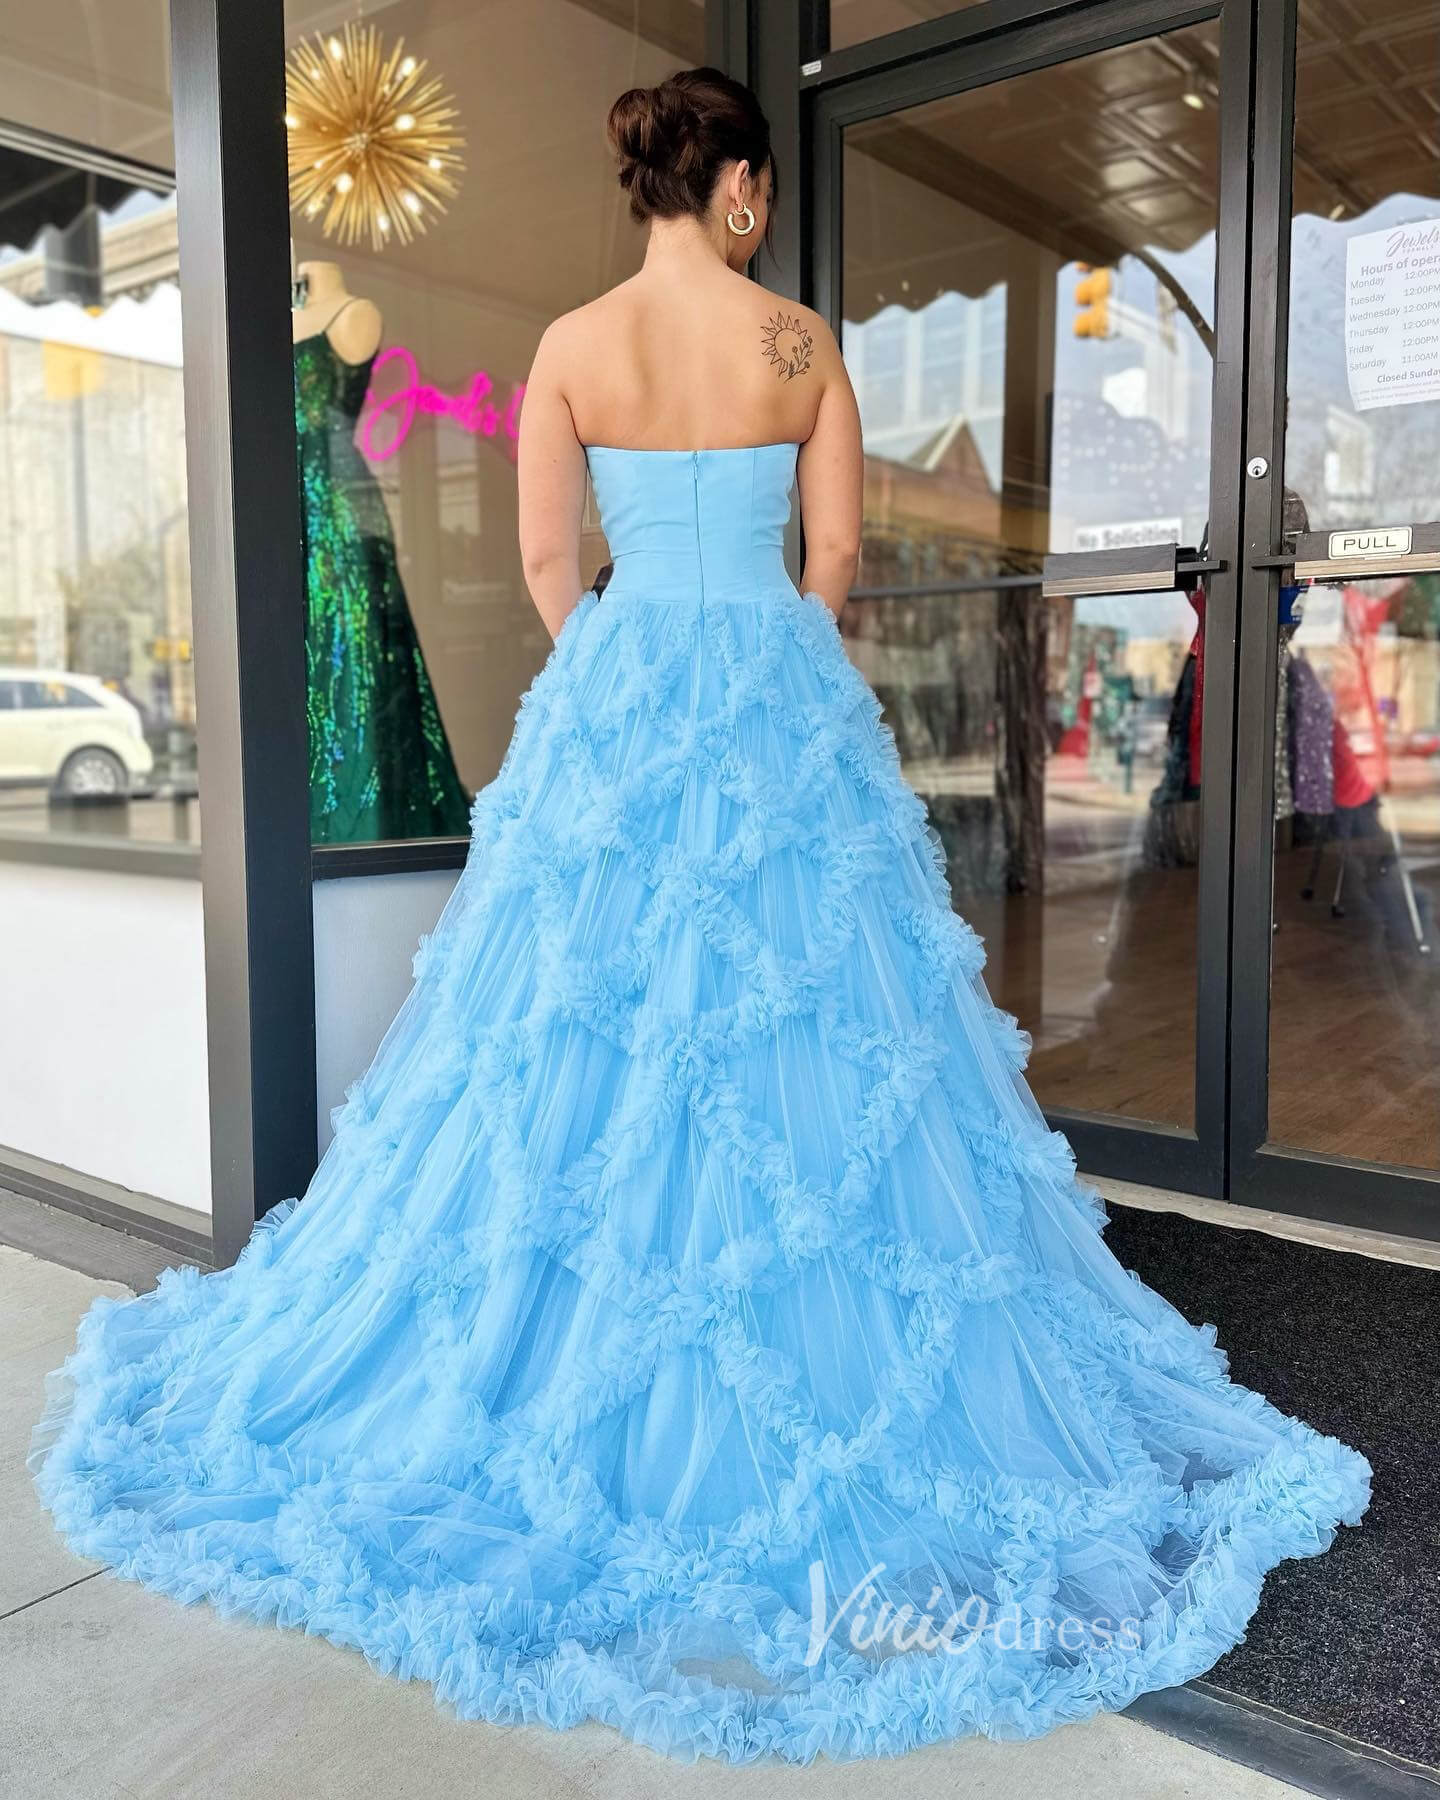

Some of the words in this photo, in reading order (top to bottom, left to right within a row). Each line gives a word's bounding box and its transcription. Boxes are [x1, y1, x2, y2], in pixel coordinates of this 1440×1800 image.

[1361, 262, 1394, 277] Hours
[1396, 257, 1409, 270] of
[1350, 277, 1385, 290] Monday
[1350, 293, 1386, 306] Tuesday
[1403, 284, 1440, 297] 12:00PM
[1349, 306, 1401, 322] Wednesday
[1402, 301, 1440, 314] 12:00PM
[1349, 325, 1391, 338] Thursday
[1402, 318, 1440, 330] 12:00PM
[1348, 344, 1375, 356] Friday
[1402, 335, 1439, 348] 12:00PM
[1349, 358, 1388, 372] Saturday
[1401, 351, 1438, 364] 11:00AM
[1376, 371, 1407, 384] Closed
[1343, 535, 1397, 551] PULL
